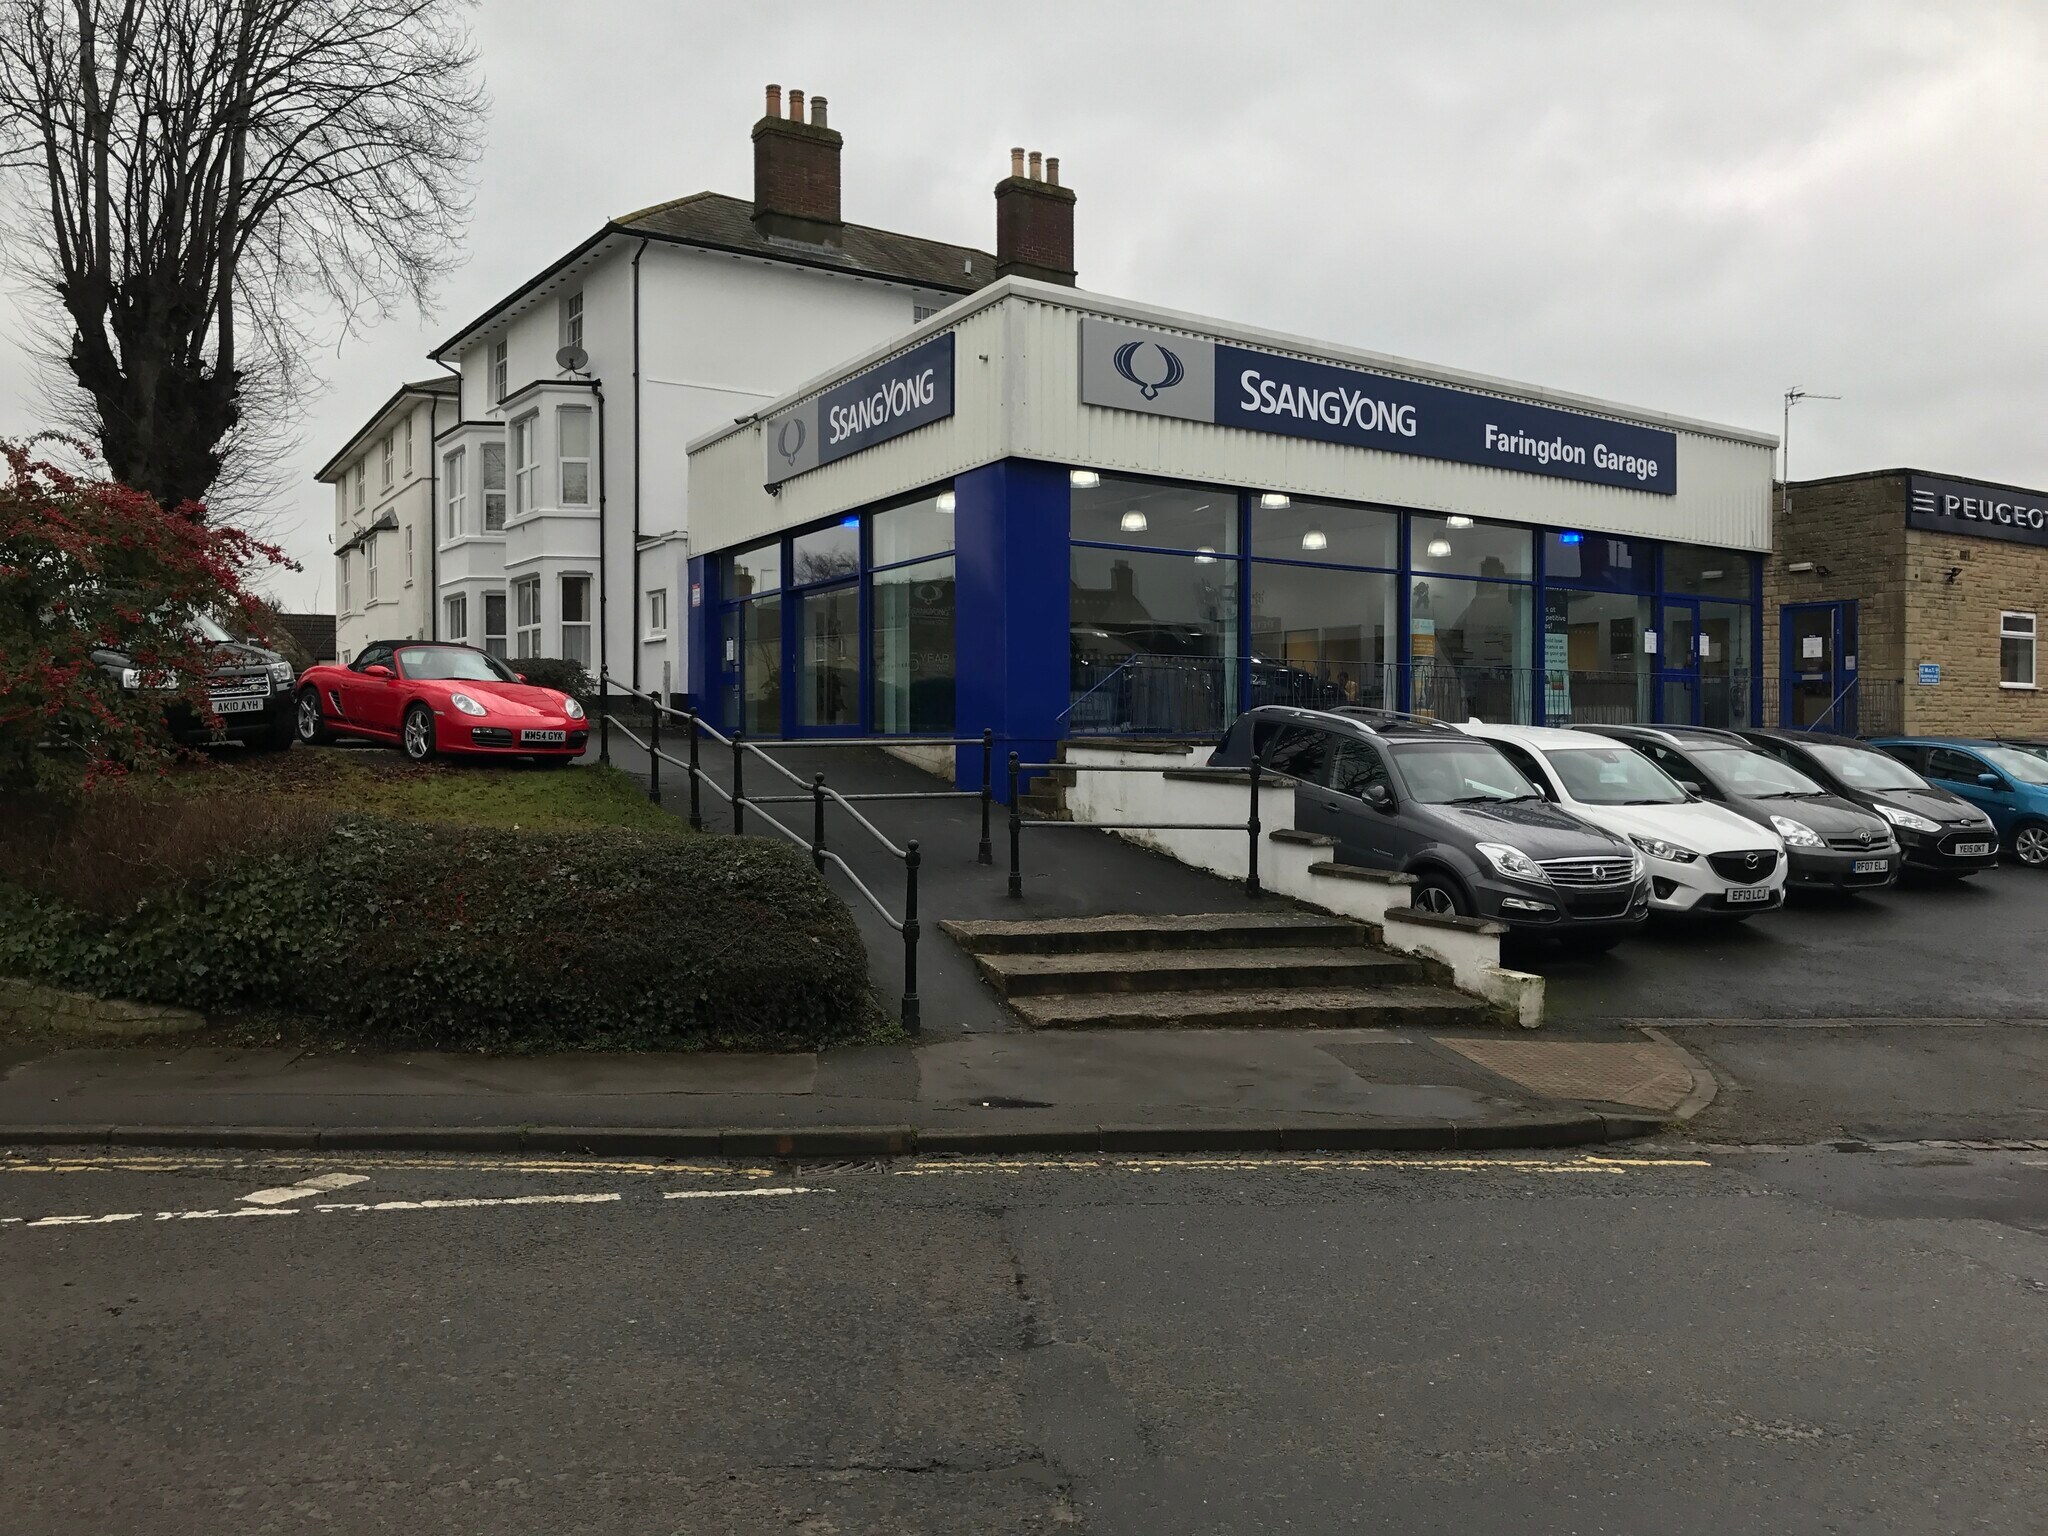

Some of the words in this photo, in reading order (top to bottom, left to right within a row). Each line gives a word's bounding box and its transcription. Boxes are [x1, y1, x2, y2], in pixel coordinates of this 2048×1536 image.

[1485, 424, 1586, 465] Faringdon
[1593, 443, 1658, 481] Garage
[1944, 494, 2048, 529] PEUGEO
[217, 701, 239, 712] AK10
[241, 700, 259, 710] AYH
[548, 731, 564, 741] GYK
[1856, 861, 1874, 871] RF07
[1874, 861, 1888, 871] ELJ
[1732, 890, 1751, 901] EF13
[1752, 889, 1766, 900] LCJ
